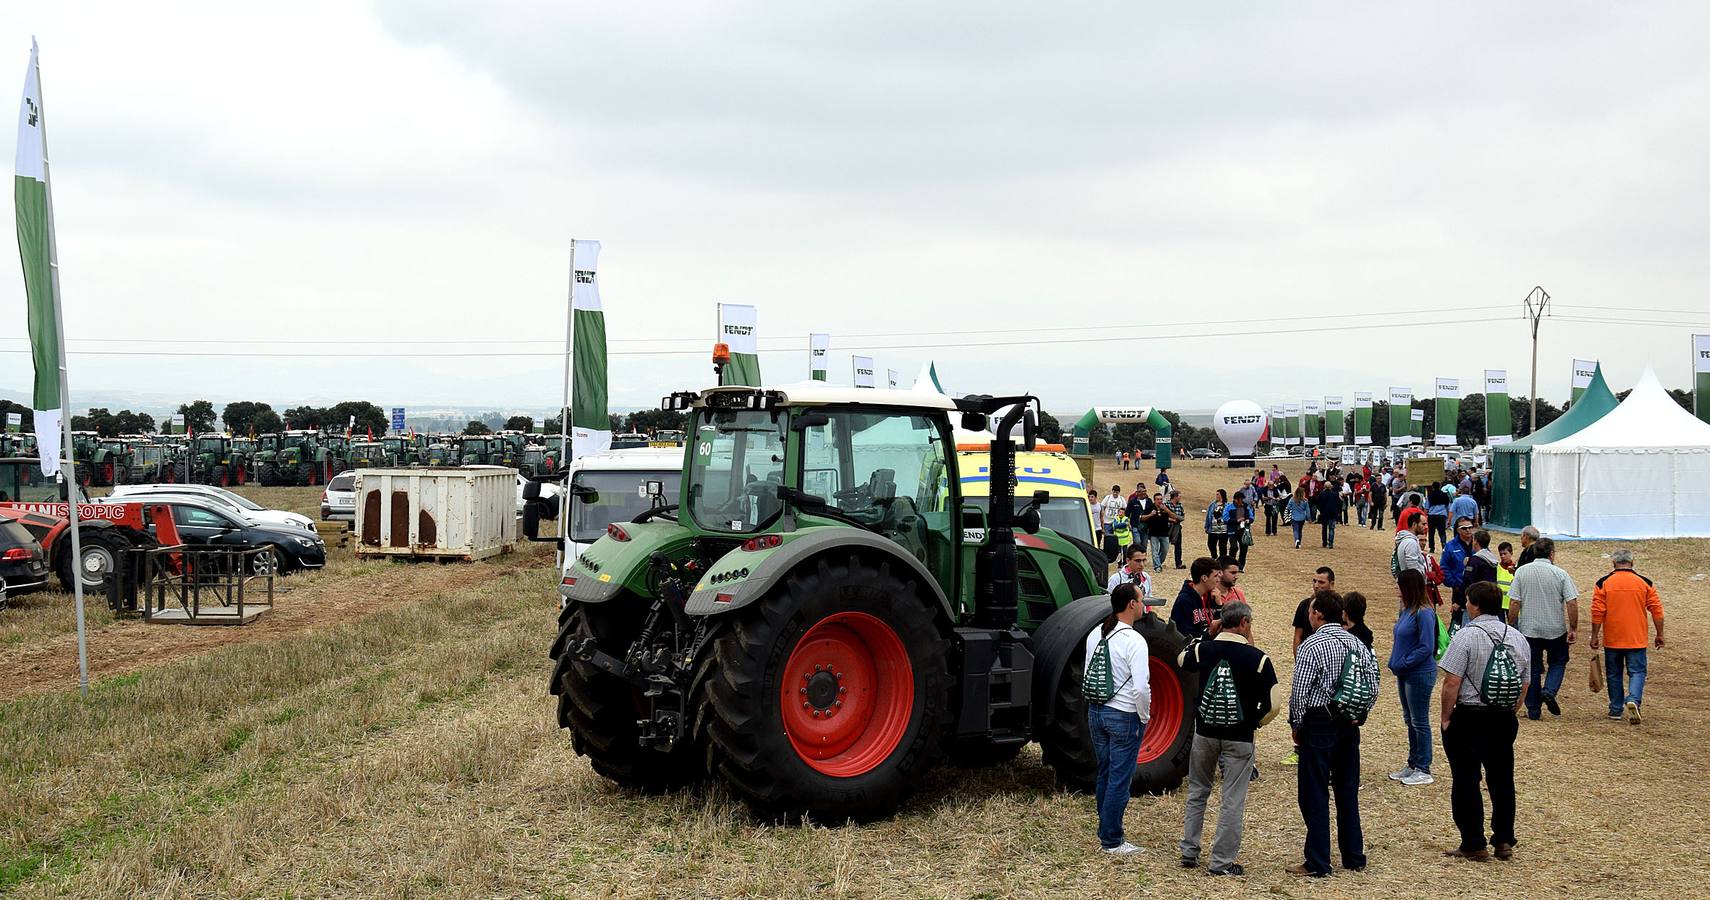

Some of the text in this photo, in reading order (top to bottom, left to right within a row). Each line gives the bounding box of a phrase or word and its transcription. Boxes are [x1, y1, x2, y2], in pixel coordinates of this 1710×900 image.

[724, 324, 754, 336] FENDT
[1101, 410, 1145, 419] FENDT
[1223, 415, 1262, 425] FENDT
[700, 442, 711, 456] 60
[963, 530, 985, 540] END
